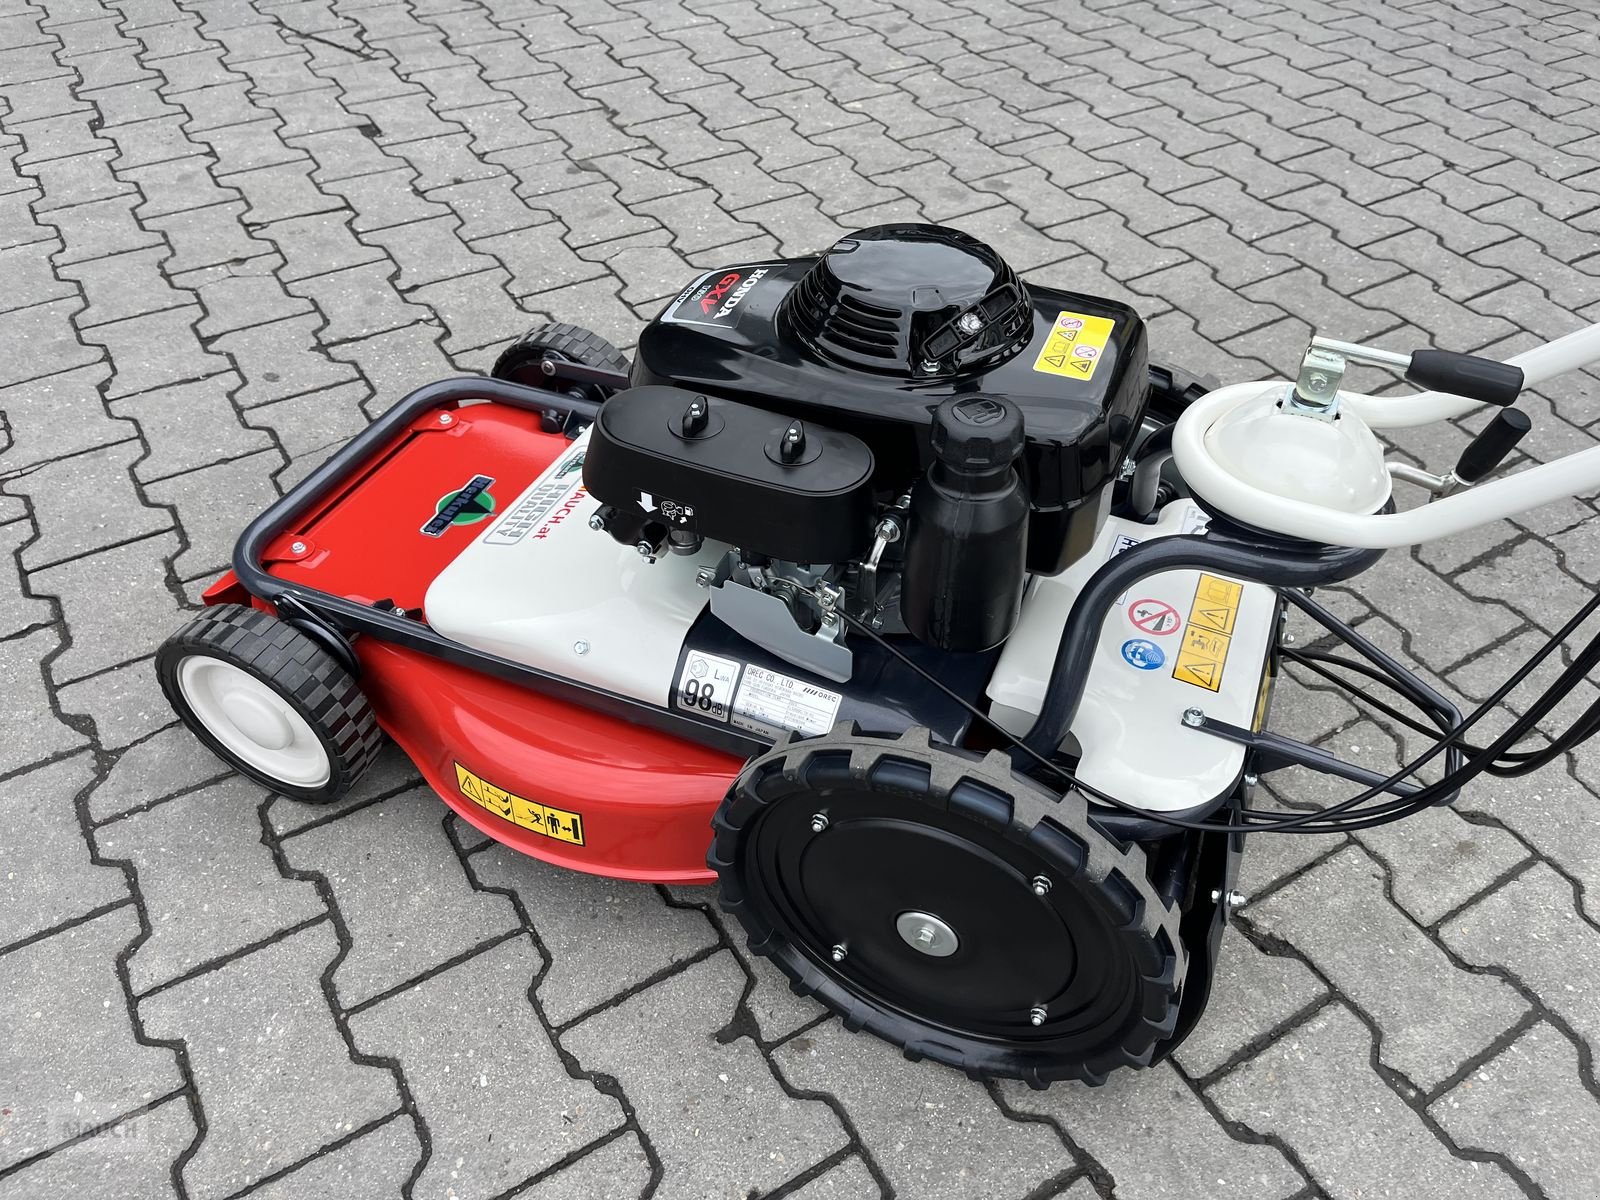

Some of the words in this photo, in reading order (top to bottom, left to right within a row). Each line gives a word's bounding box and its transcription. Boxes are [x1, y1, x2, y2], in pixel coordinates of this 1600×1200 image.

[677, 286, 695, 304] OHV
[700, 273, 741, 315] GXV
[713, 268, 769, 320] HONDA
[425, 476, 493, 535] Herkules
[496, 484, 555, 536] QUALITY
[507, 484, 570, 538] HIGH
[747, 667, 763, 679] OREC
[684, 678, 715, 712] 98
[711, 702, 723, 716] dB
[817, 691, 837, 703] OREC
